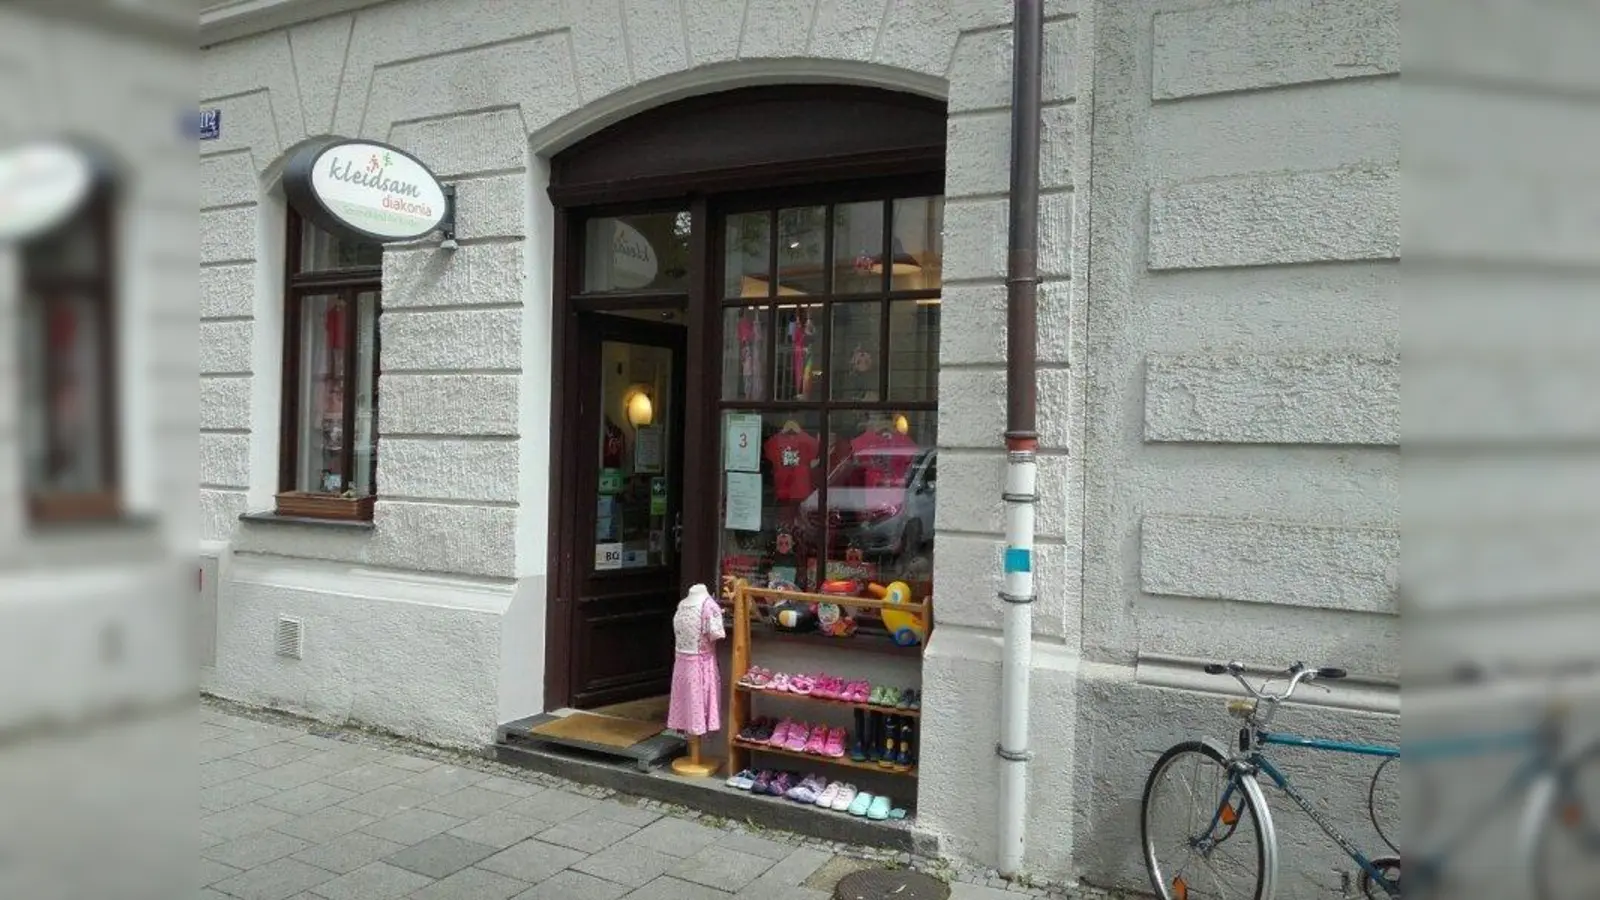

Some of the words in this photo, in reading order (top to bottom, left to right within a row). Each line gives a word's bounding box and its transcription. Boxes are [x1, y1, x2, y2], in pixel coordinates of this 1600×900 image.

[329, 156, 420, 198] kleidsam
[382, 195, 432, 217] diakonia
[738, 432, 748, 448] 3
